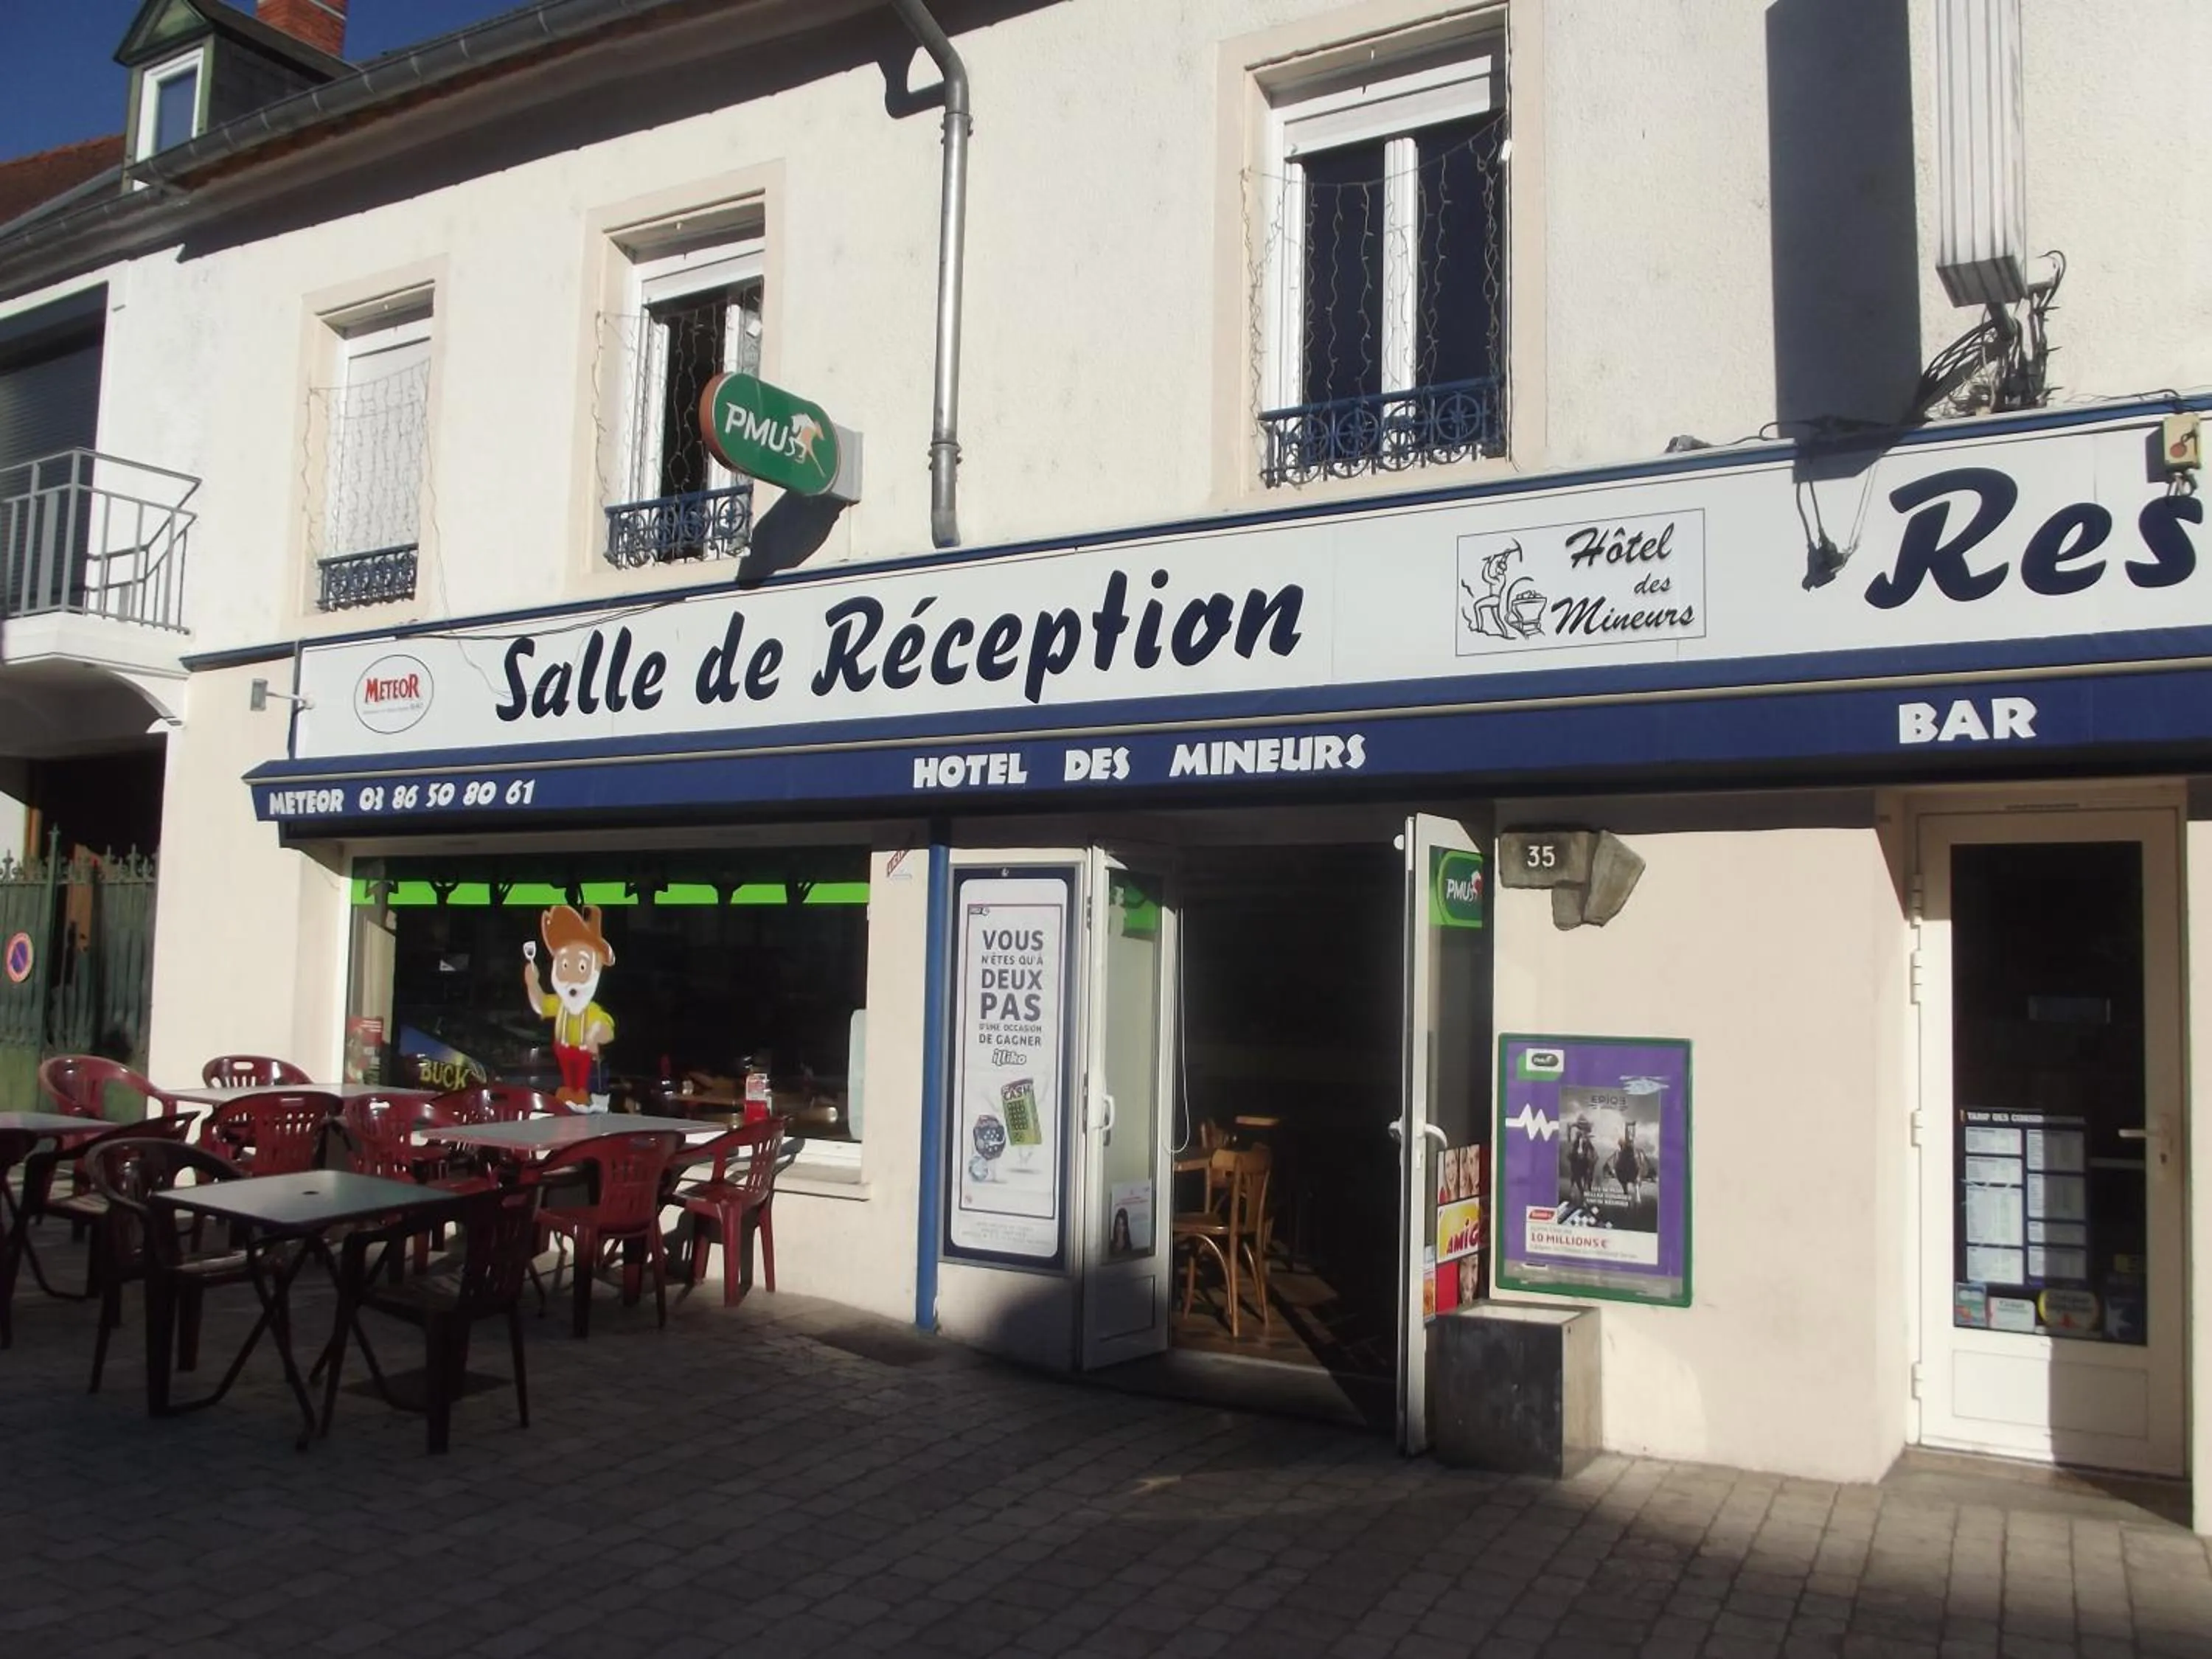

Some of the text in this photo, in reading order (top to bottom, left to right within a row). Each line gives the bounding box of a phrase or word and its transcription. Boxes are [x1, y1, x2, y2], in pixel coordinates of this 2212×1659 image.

[725, 403, 788, 451] PMU
[1565, 523, 1674, 566] Hôtel
[1864, 467, 2203, 610] Res
[1633, 573, 1672, 596] des
[1551, 597, 1695, 636] Mineurs
[495, 568, 1304, 722] Salle de Réception
[364, 672, 420, 703] METEOR
[1899, 697, 2037, 744] BAR
[913, 734, 1367, 788] HOTEL DES MINEURS
[269, 779, 536, 815] METEOR 03 86 50 80 61
[1527, 846, 1555, 867] 35
[1446, 878, 1472, 901] PMU
[981, 930, 1044, 951] VOUS
[981, 968, 1043, 990] DEUX
[980, 992, 1042, 1022] PAS
[978, 1033, 1042, 1046] DE GAGNER
[419, 1058, 472, 1091] BUCK
[1530, 1232, 1545, 1242] 10
[1546, 1234, 1599, 1248] MILLIONS
